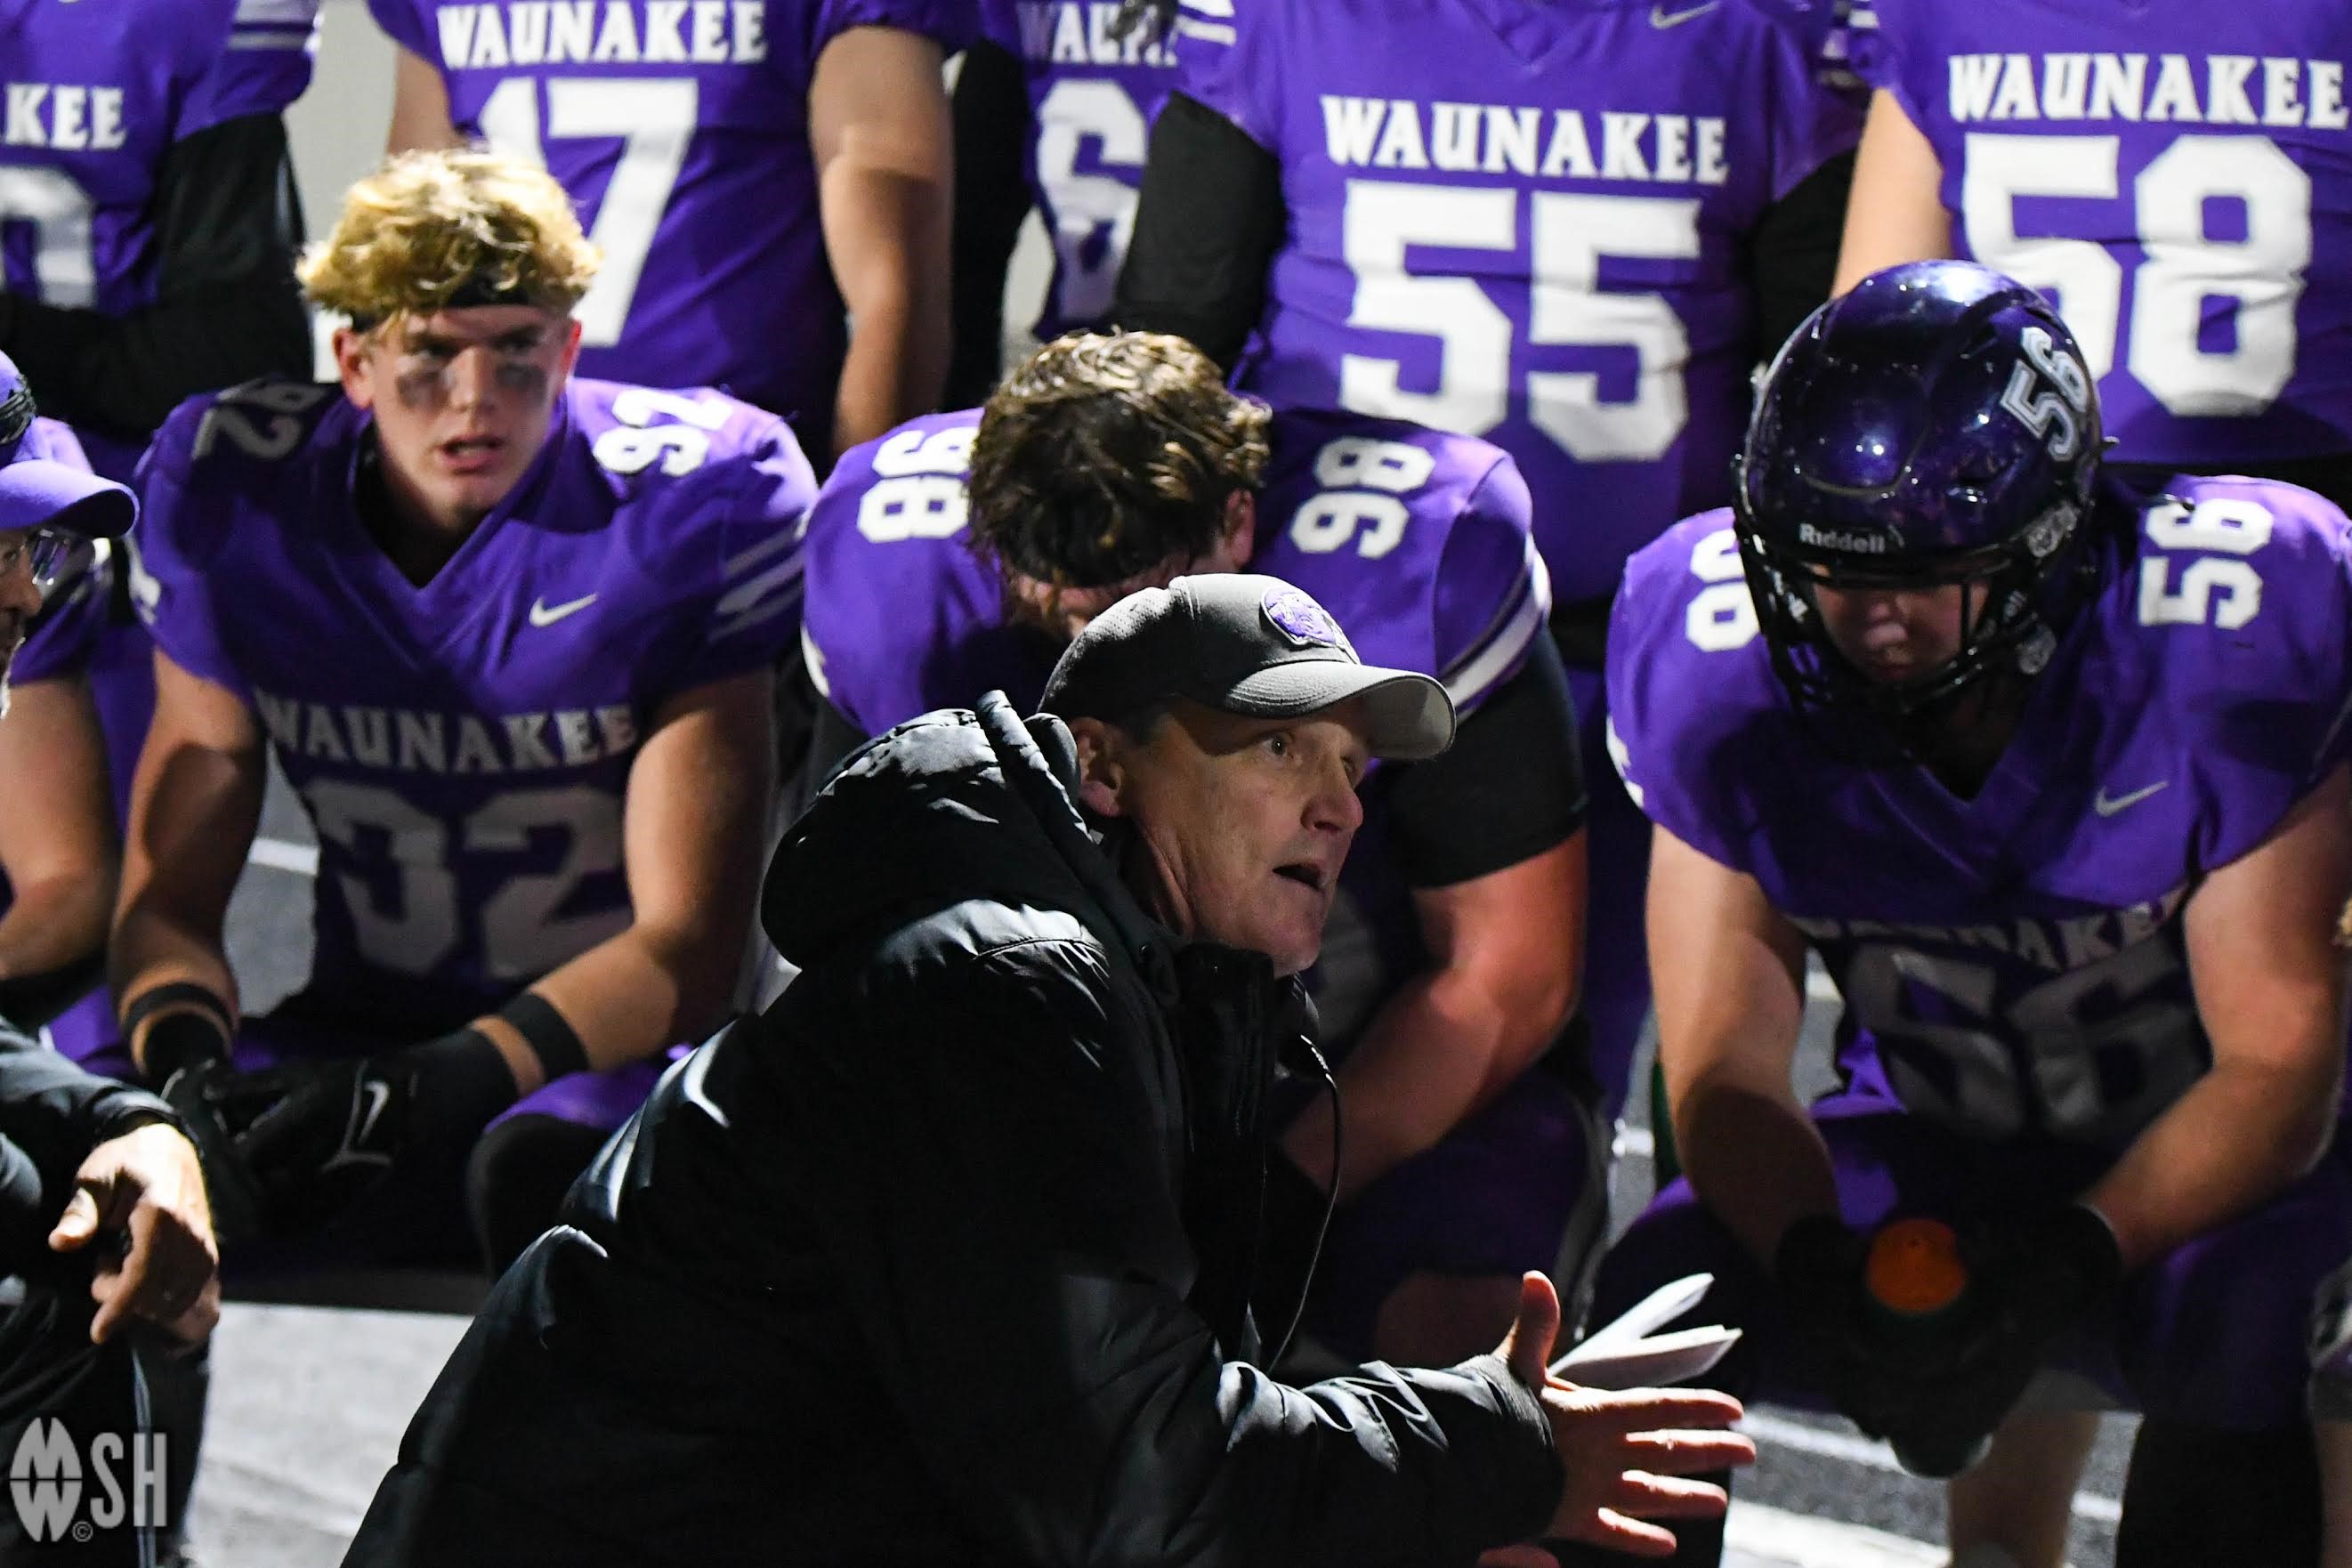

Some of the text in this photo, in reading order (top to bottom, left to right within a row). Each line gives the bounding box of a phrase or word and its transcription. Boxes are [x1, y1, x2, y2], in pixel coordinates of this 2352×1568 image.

[436, 0, 767, 70] WAUNAKEE
[1947, 53, 2350, 129] WAUNAKEE
[1320, 94, 1729, 185] WAUNAKEE
[1339, 178, 1701, 464] 55
[1961, 133, 2314, 418] 58
[2000, 326, 2089, 463] 56
[1290, 437, 1435, 560] 98
[1799, 522, 1885, 554] Riddell
[2139, 496, 2275, 630] 56
